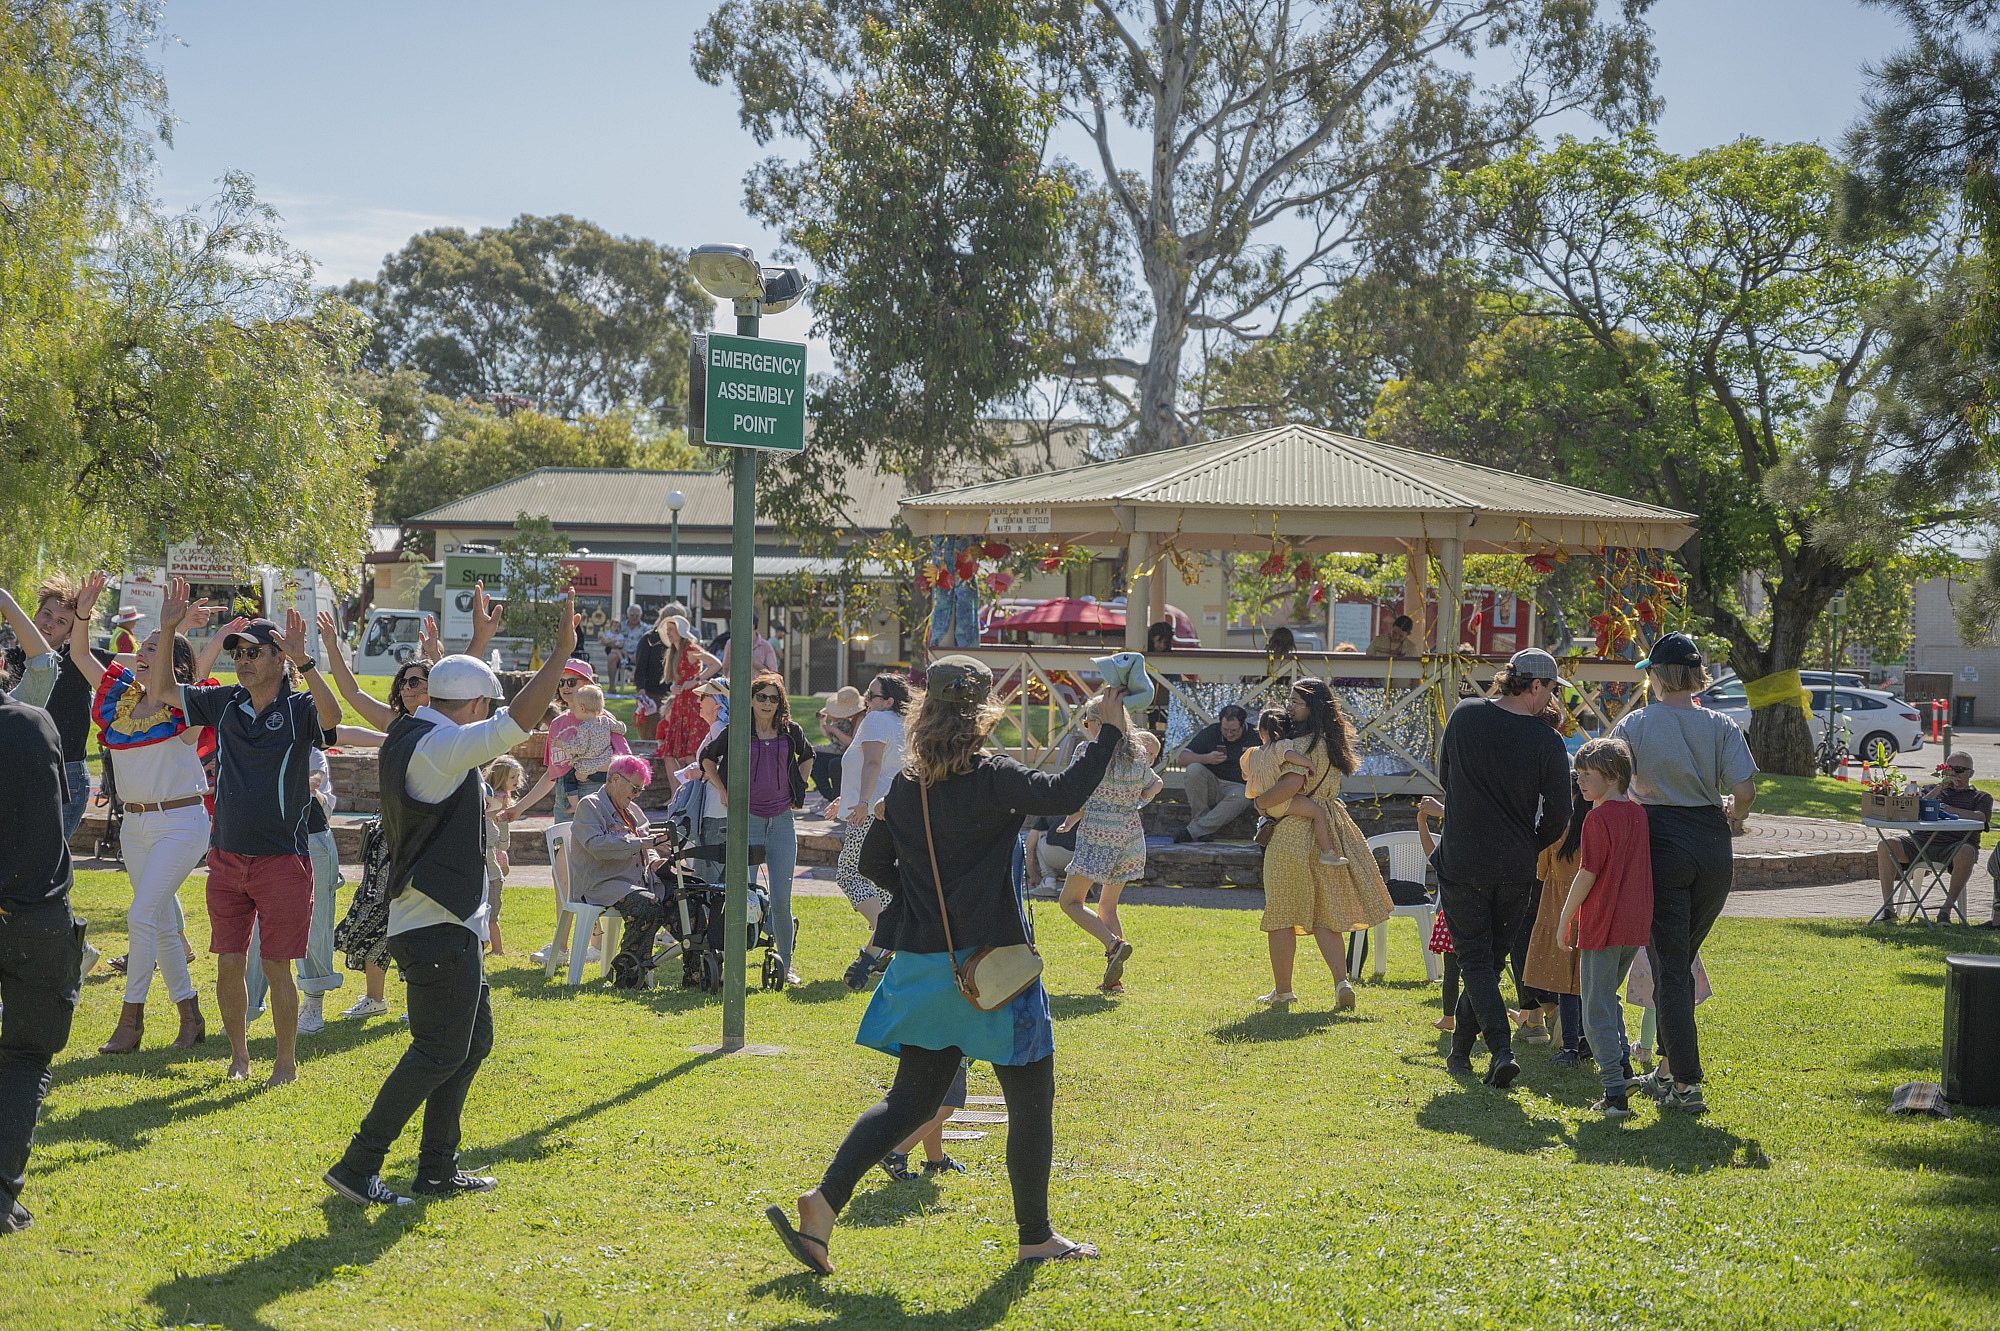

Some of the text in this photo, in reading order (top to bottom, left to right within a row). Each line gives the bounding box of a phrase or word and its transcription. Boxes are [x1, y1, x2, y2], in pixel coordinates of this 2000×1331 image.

[711, 349, 801, 375] EMERGENCY
[717, 381, 795, 406] ASSEMBLY
[733, 413, 777, 435] POINT
[1035, 507, 1048, 515] PLAY
[1026, 516, 1049, 524] RECYCLED
[130, 589, 155, 598] MENU
